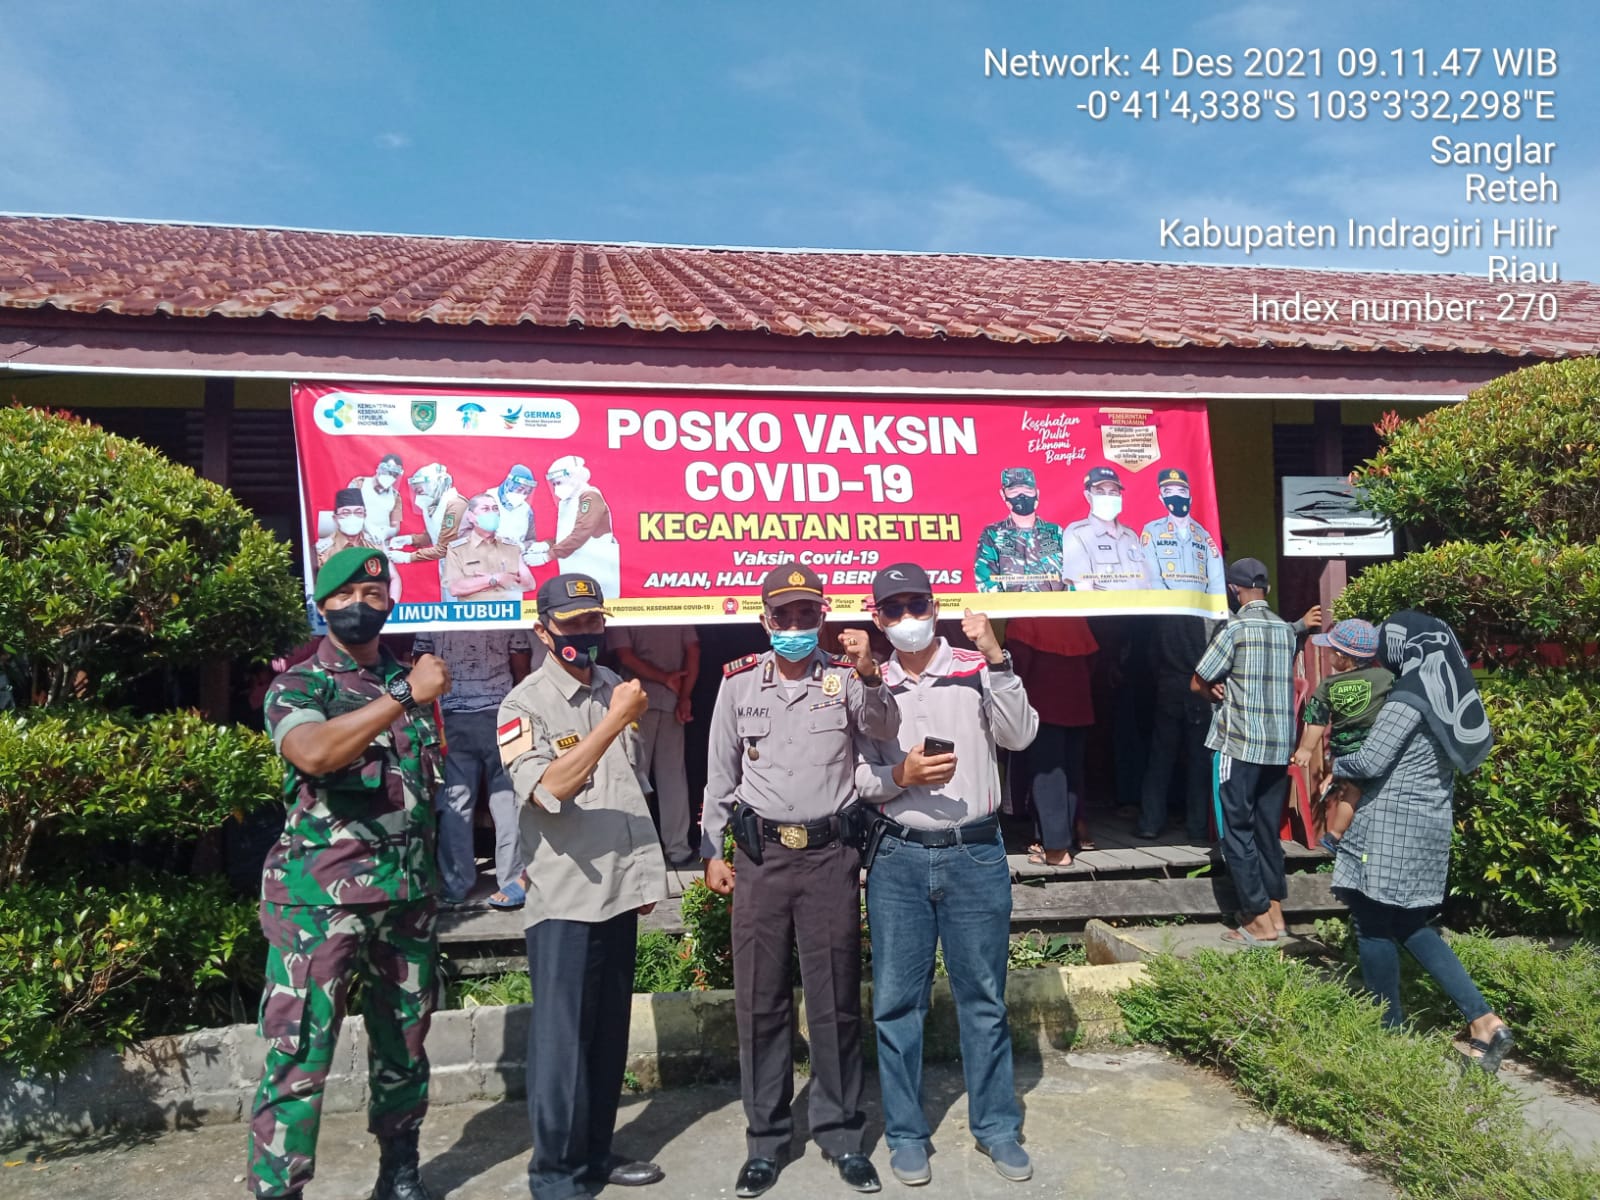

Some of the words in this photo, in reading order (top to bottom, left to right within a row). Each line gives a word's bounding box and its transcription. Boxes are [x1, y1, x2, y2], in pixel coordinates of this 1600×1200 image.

[524, 411, 562, 419] GERMAS
[1021, 410, 1080, 431] Kesehatan
[607, 409, 782, 453] POSKO
[793, 413, 978, 455] VAKSIN
[1039, 426, 1071, 444] Pulih
[1028, 438, 1071, 453] Ekonomi
[1045, 447, 1086, 466] Bangkit
[684, 461, 914, 503] COVID-19
[639, 513, 850, 541] KECAMATAN
[857, 514, 961, 541] RETEH
[733, 550, 795, 566] Vaksin
[800, 551, 879, 566] Covid-19
[644, 572, 711, 590] AMAN,
[399, 605, 448, 620] IMUN
[453, 603, 514, 619] TUBUH
[1337, 684, 1362, 694] ARMY
